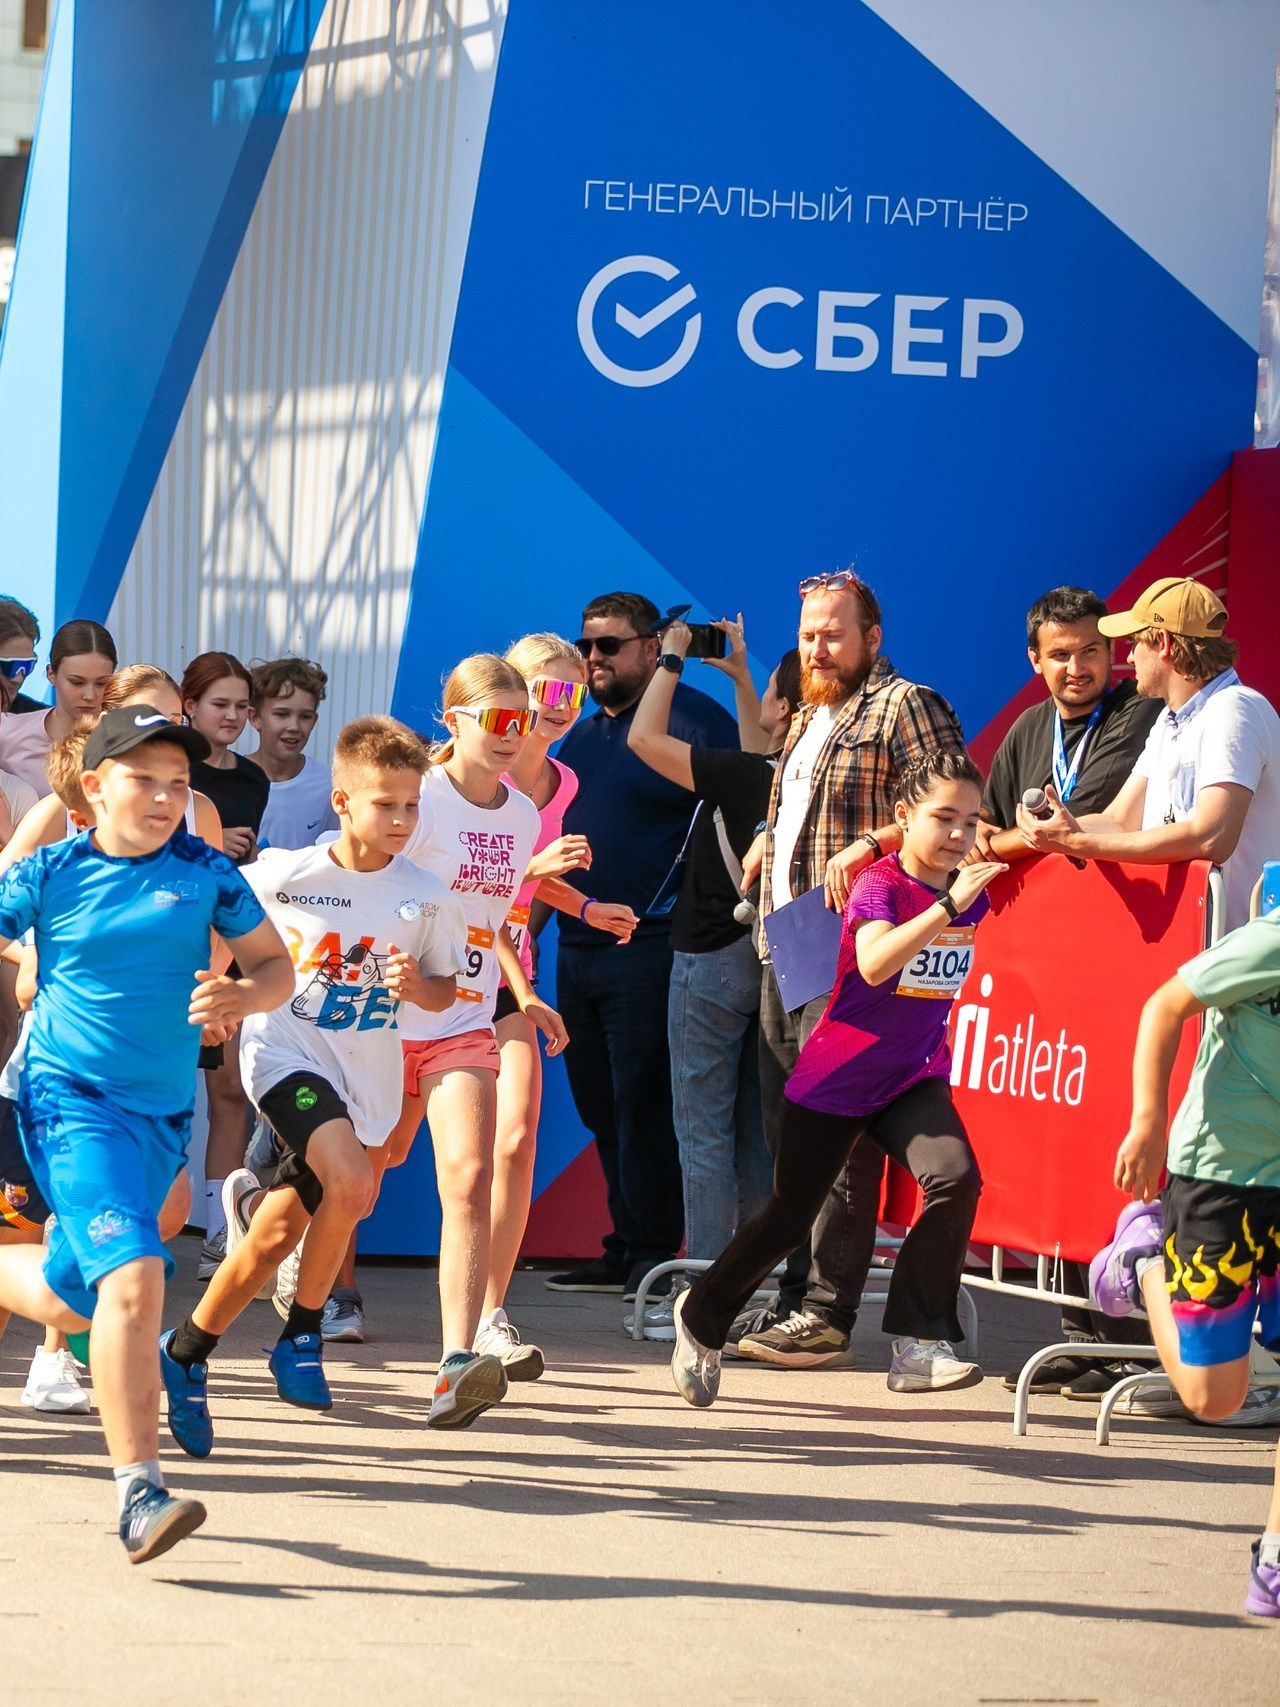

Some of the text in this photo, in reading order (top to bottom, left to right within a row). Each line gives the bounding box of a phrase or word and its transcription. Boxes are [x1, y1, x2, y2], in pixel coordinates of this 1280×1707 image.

[583, 180, 1029, 232] ГЕНЕРАЛЬНЫЙ ПАРТНЁР
[736, 286, 1025, 379] СБЕР
[459, 831, 514, 851] CREATE
[292, 895, 352, 908] РОСАТОМ
[419, 901, 440, 912] АТОМ
[909, 949, 970, 979] 3104
[947, 973, 1087, 1106] riatleta
